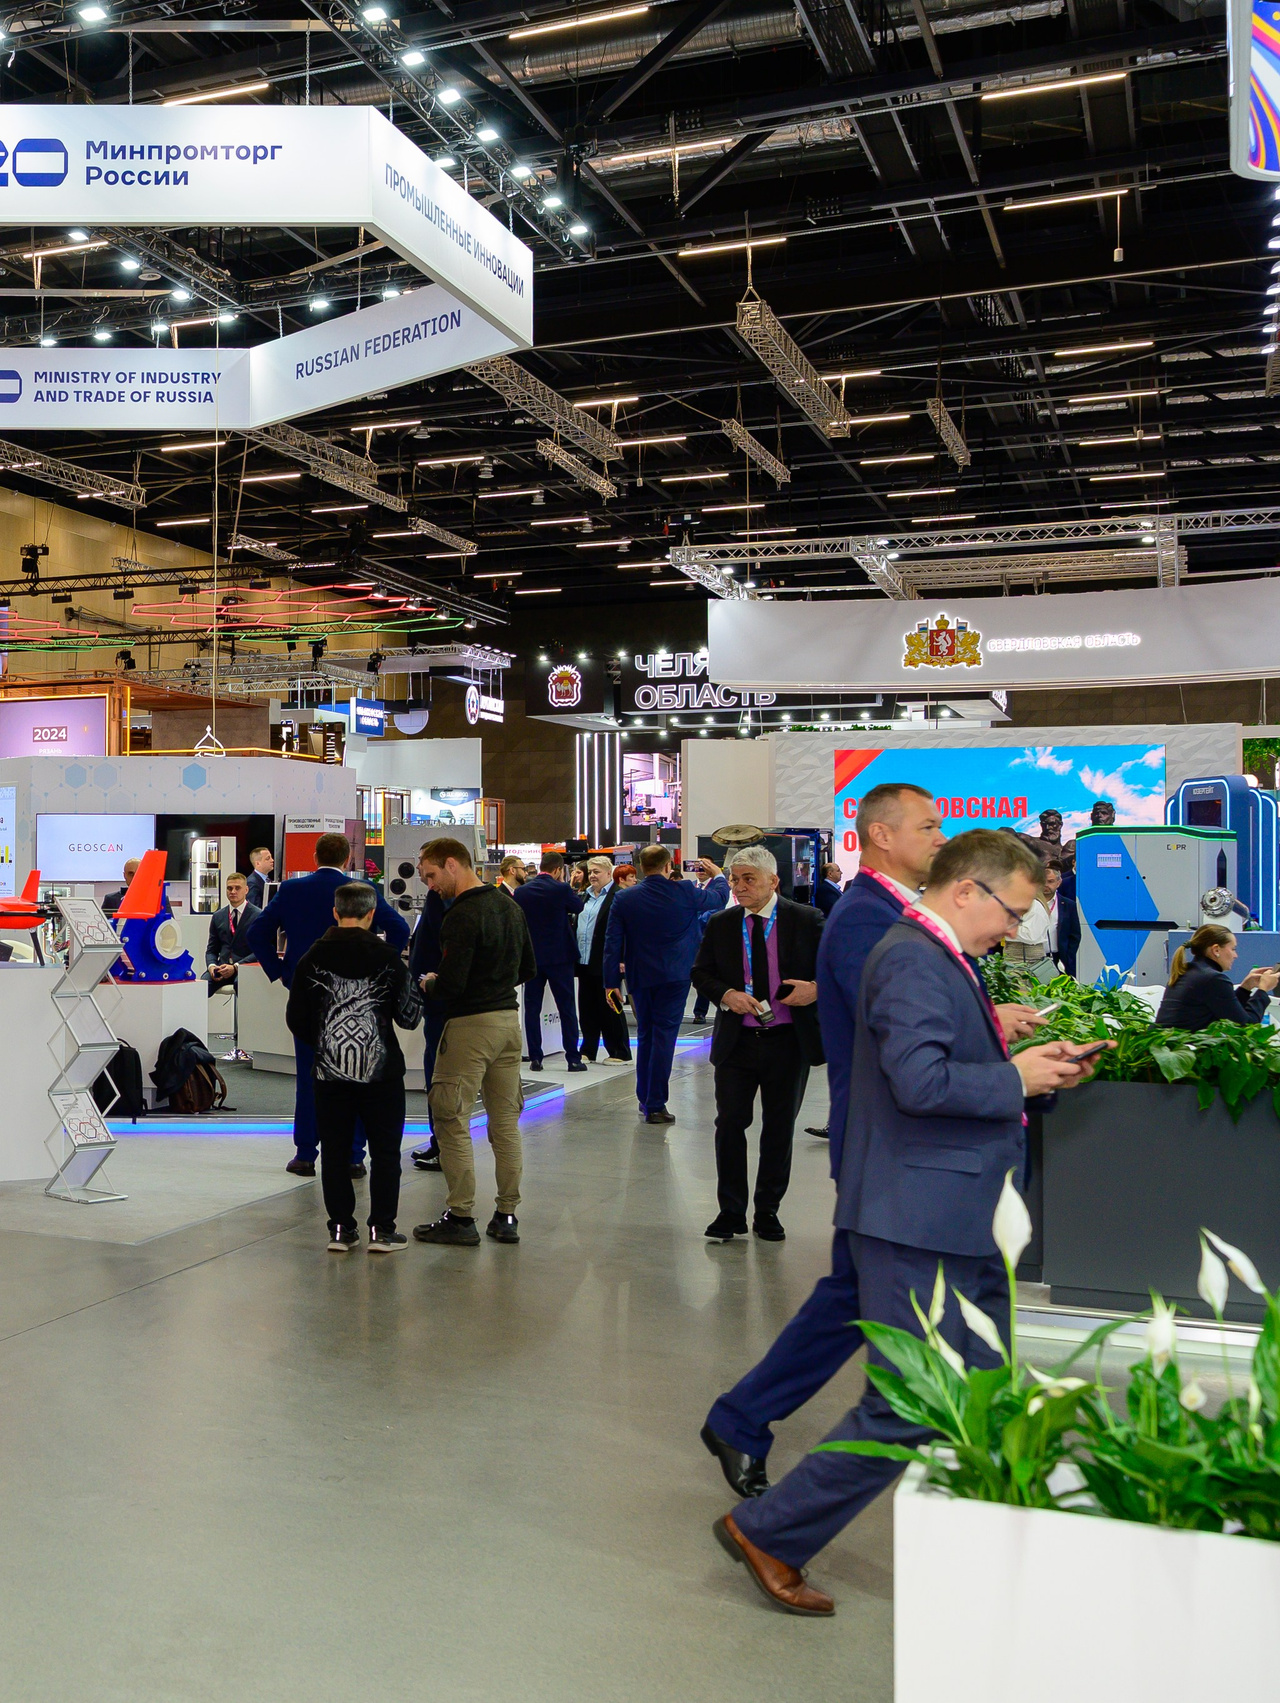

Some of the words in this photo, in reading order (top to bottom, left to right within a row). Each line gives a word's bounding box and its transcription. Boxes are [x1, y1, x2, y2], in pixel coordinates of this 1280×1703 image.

[85, 140, 282, 164] Минпромторг
[85, 166, 188, 185] России
[385, 163, 471, 254] ПРОМЫШЛЕННЫЕ
[474, 238, 524, 298] ИННОВАЦИИ
[296, 344, 359, 380] RUSSIAN
[364, 309, 461, 357] FEDERATION
[34, 371, 111, 384] MINISTRY
[115, 371, 137, 384] OF
[141, 371, 221, 384] INDUSTRY
[34, 390, 69, 403] AND
[73, 390, 126, 403] TRADE
[130, 390, 152, 403] OF
[156, 390, 214, 403] RUSSIA
[987, 636, 1082, 652] СВЕРДЛОВСКАЯ
[1085, 633, 1141, 648] ОБЛАСТЬ
[635, 652, 709, 678] ЧЕЛЯ
[34, 728, 66, 740] 2024
[843, 797, 1027, 819] СОВСКАЯ
[68, 843, 123, 852] GEOSCAN
